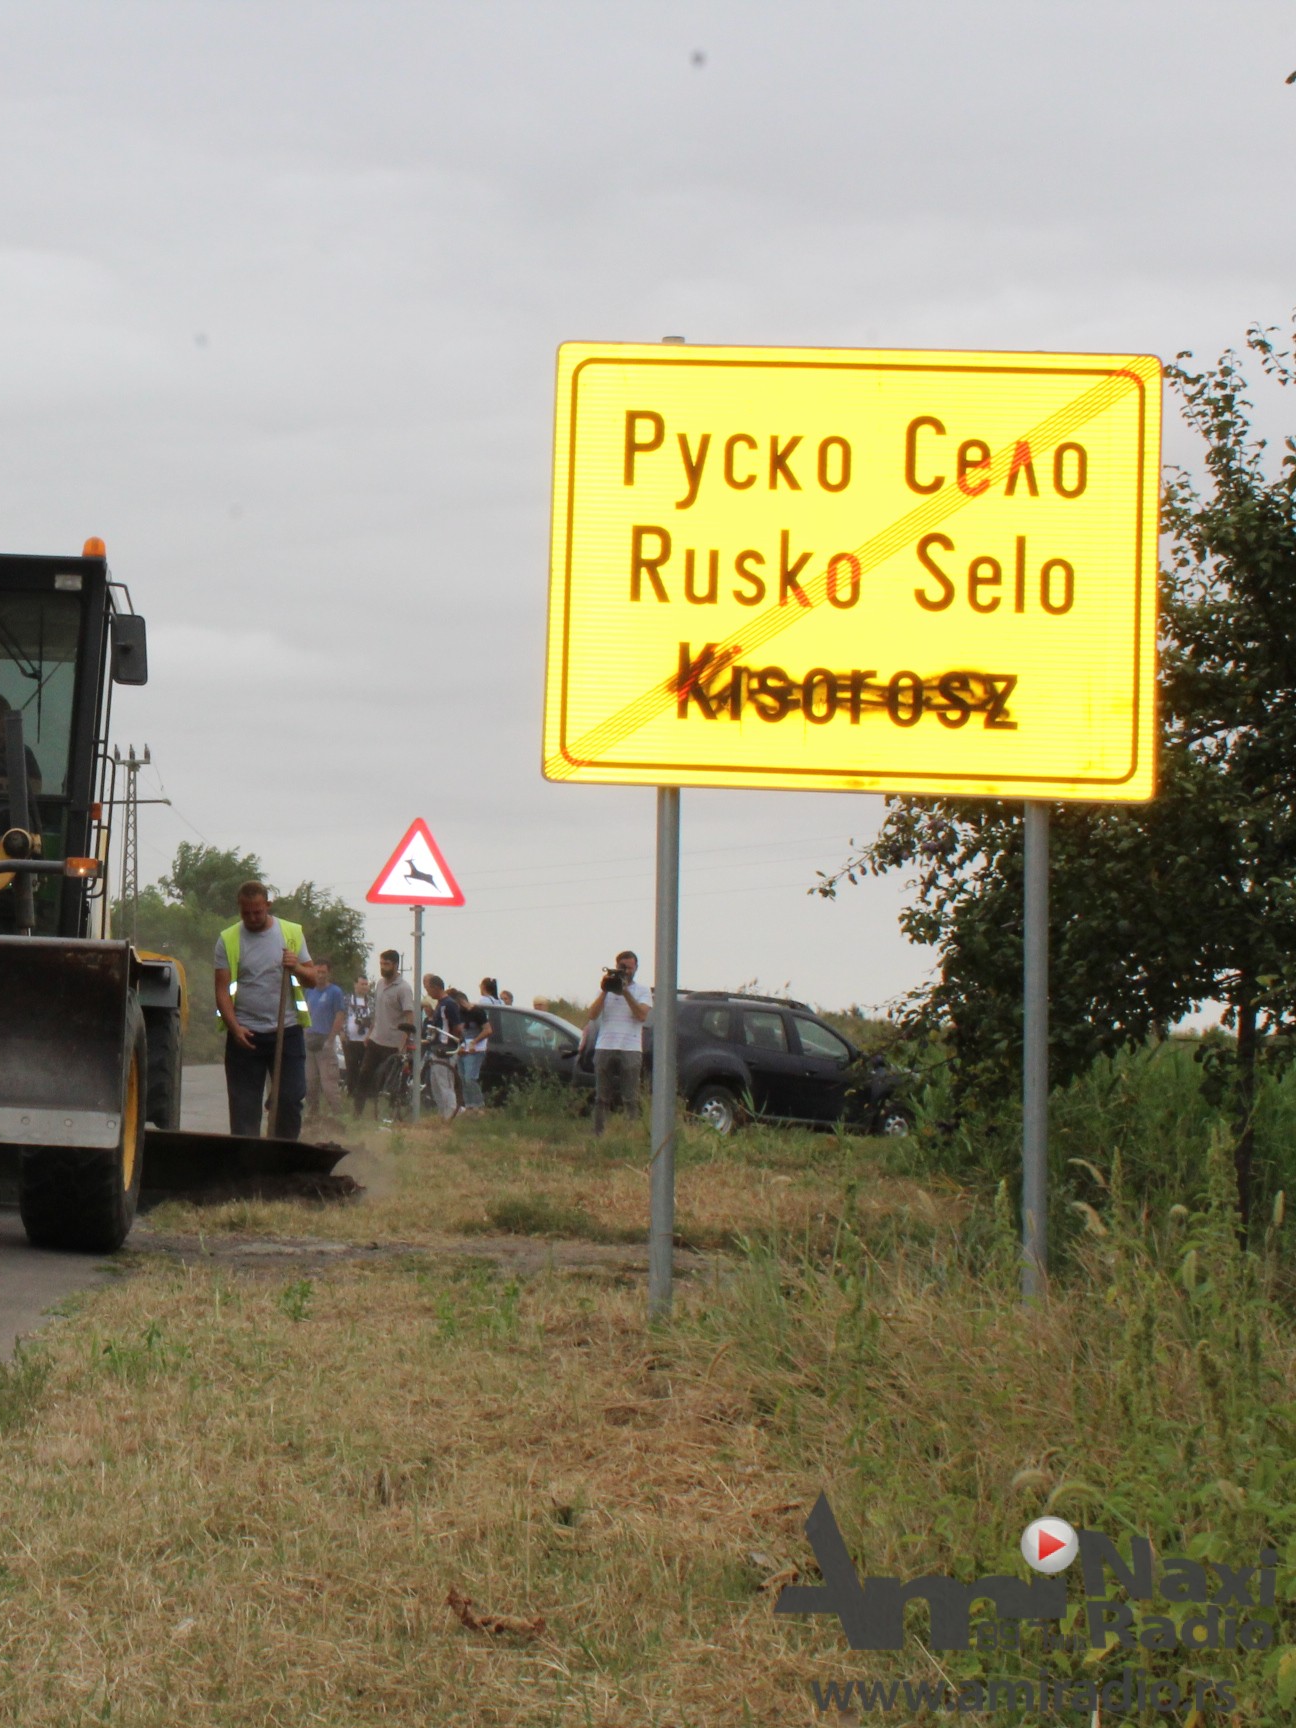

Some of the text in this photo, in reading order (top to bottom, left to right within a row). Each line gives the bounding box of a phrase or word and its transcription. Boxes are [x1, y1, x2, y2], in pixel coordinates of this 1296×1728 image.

[623, 410, 1088, 510] Руско Село
[629, 525, 1075, 616] Rusko Selo
